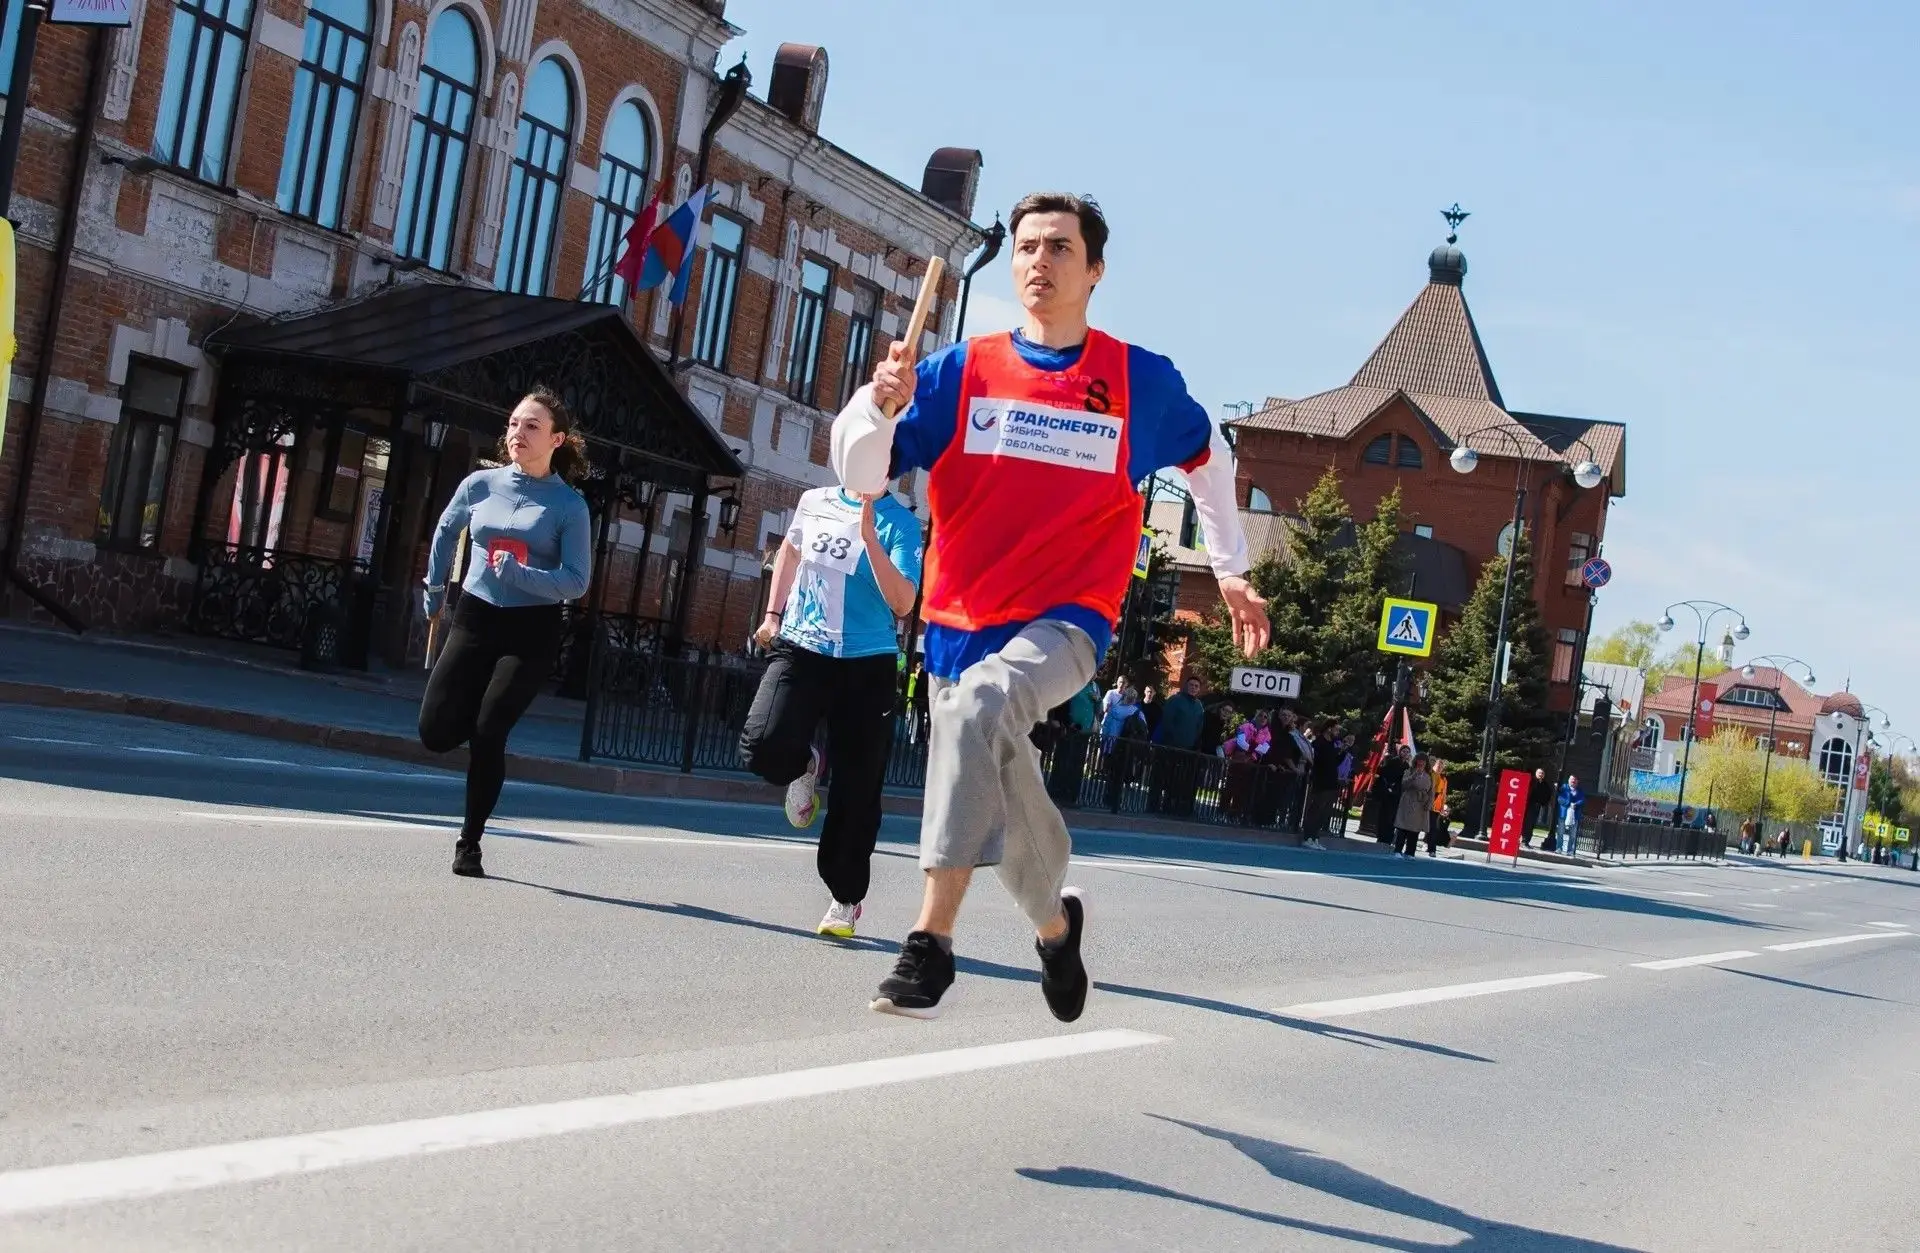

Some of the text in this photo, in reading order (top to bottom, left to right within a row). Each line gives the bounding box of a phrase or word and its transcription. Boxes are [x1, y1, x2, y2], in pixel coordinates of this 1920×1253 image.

[1084, 378, 1110, 413] 8
[1003, 424, 1049, 439] СИБИРЬ
[1006, 410, 1117, 439] ТРАНСНЕФТЬ
[1001, 438, 1097, 461] ТОБОЛЬСКОЕ УМН
[812, 532, 852, 560] 33
[1241, 672, 1291, 692] СТОП
[1499, 777, 1520, 850] СТАРТ
